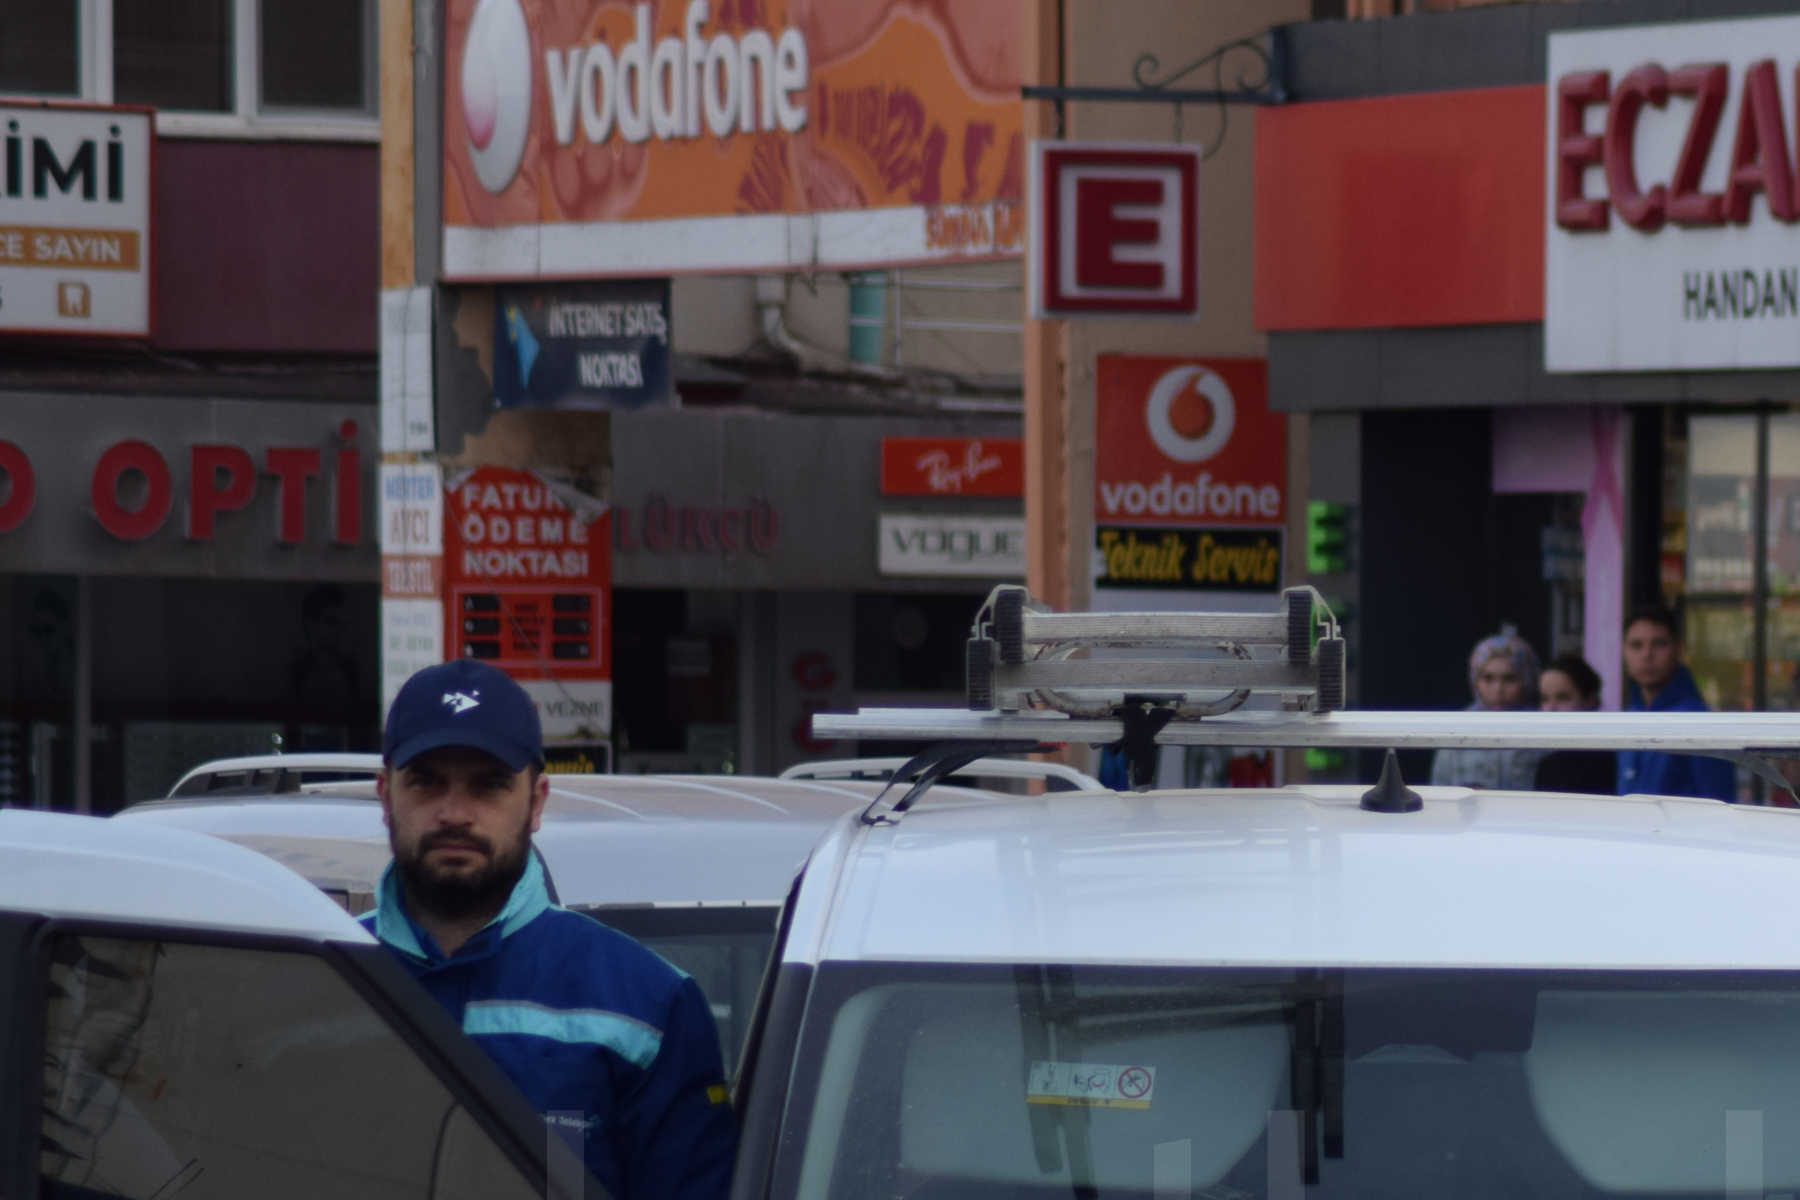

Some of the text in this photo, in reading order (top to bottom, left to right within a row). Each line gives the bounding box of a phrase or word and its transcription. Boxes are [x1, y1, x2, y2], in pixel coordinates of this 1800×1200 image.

[546, 0, 808, 146] vodafone
[34, 234, 120, 262] SAYIN
[1076, 179, 1163, 287] E
[1683, 268, 1797, 319] HANDAN
[1101, 473, 1280, 516] vodafone
[463, 514, 588, 543] ÖDEME
[463, 550, 588, 577] NOKTASI
